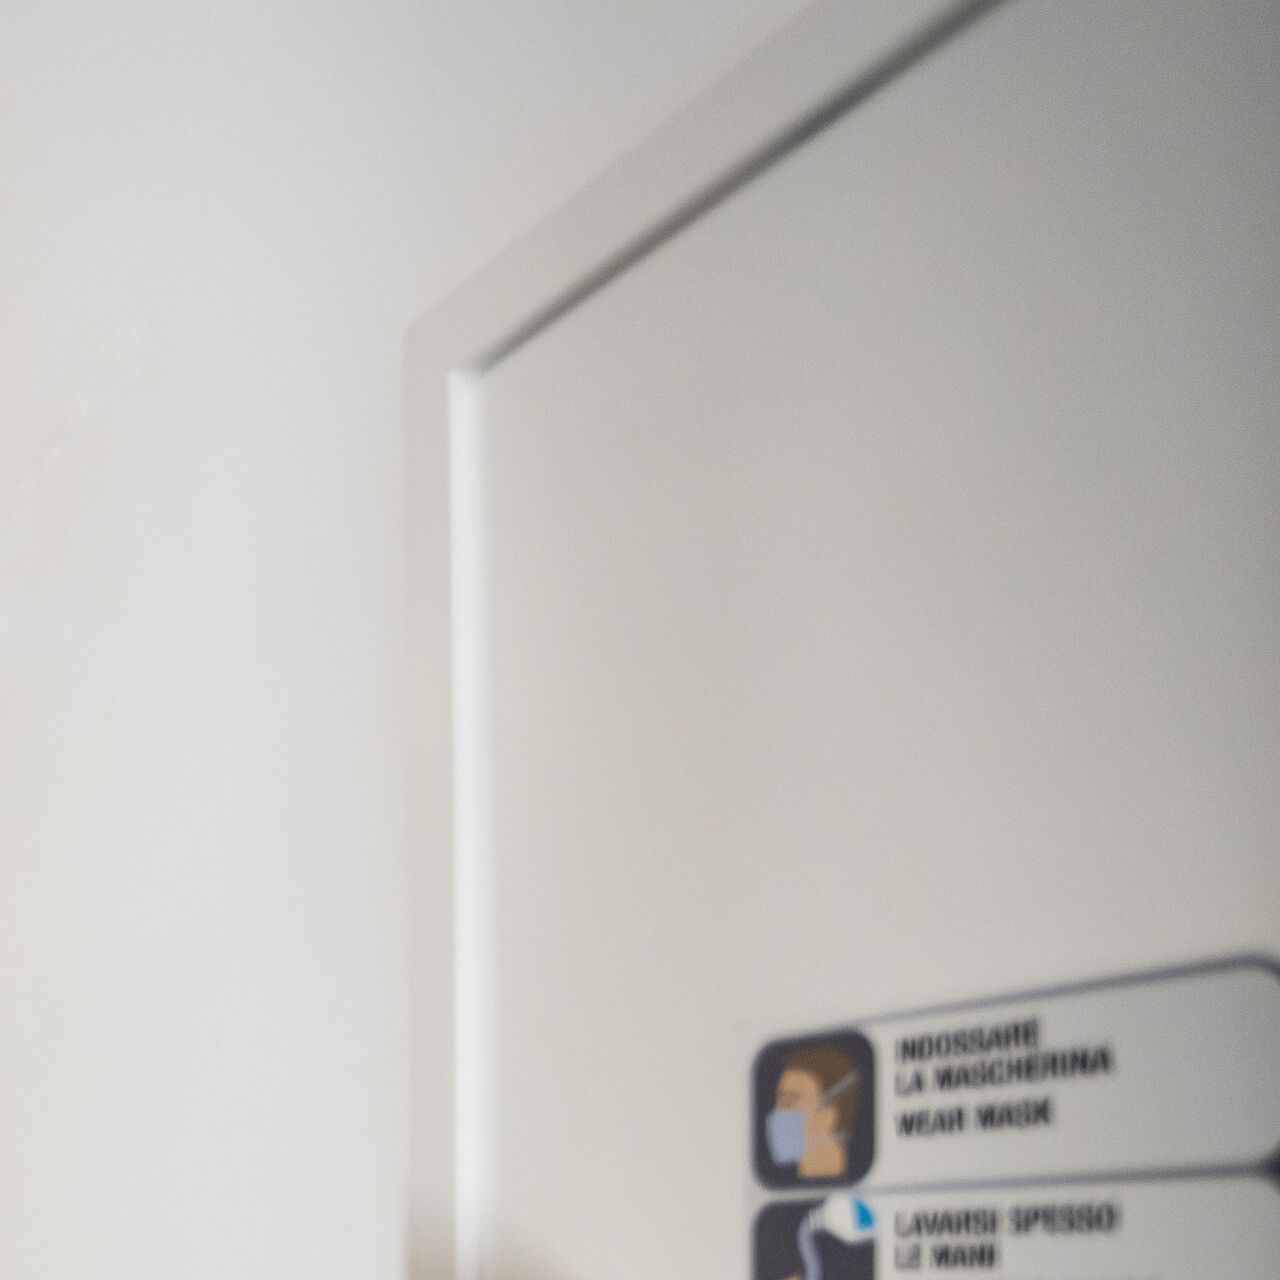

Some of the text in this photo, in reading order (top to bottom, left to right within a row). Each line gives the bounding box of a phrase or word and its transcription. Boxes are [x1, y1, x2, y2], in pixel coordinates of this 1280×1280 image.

[895, 1018, 1040, 1064] INDOSSARE
[895, 1041, 1116, 1096] LA MASCHERINA
[896, 1097, 1051, 1137] WEAR MASK
[895, 1201, 1121, 1241] LAVARSI SPESSO
[895, 1241, 997, 1271] LE MANI
